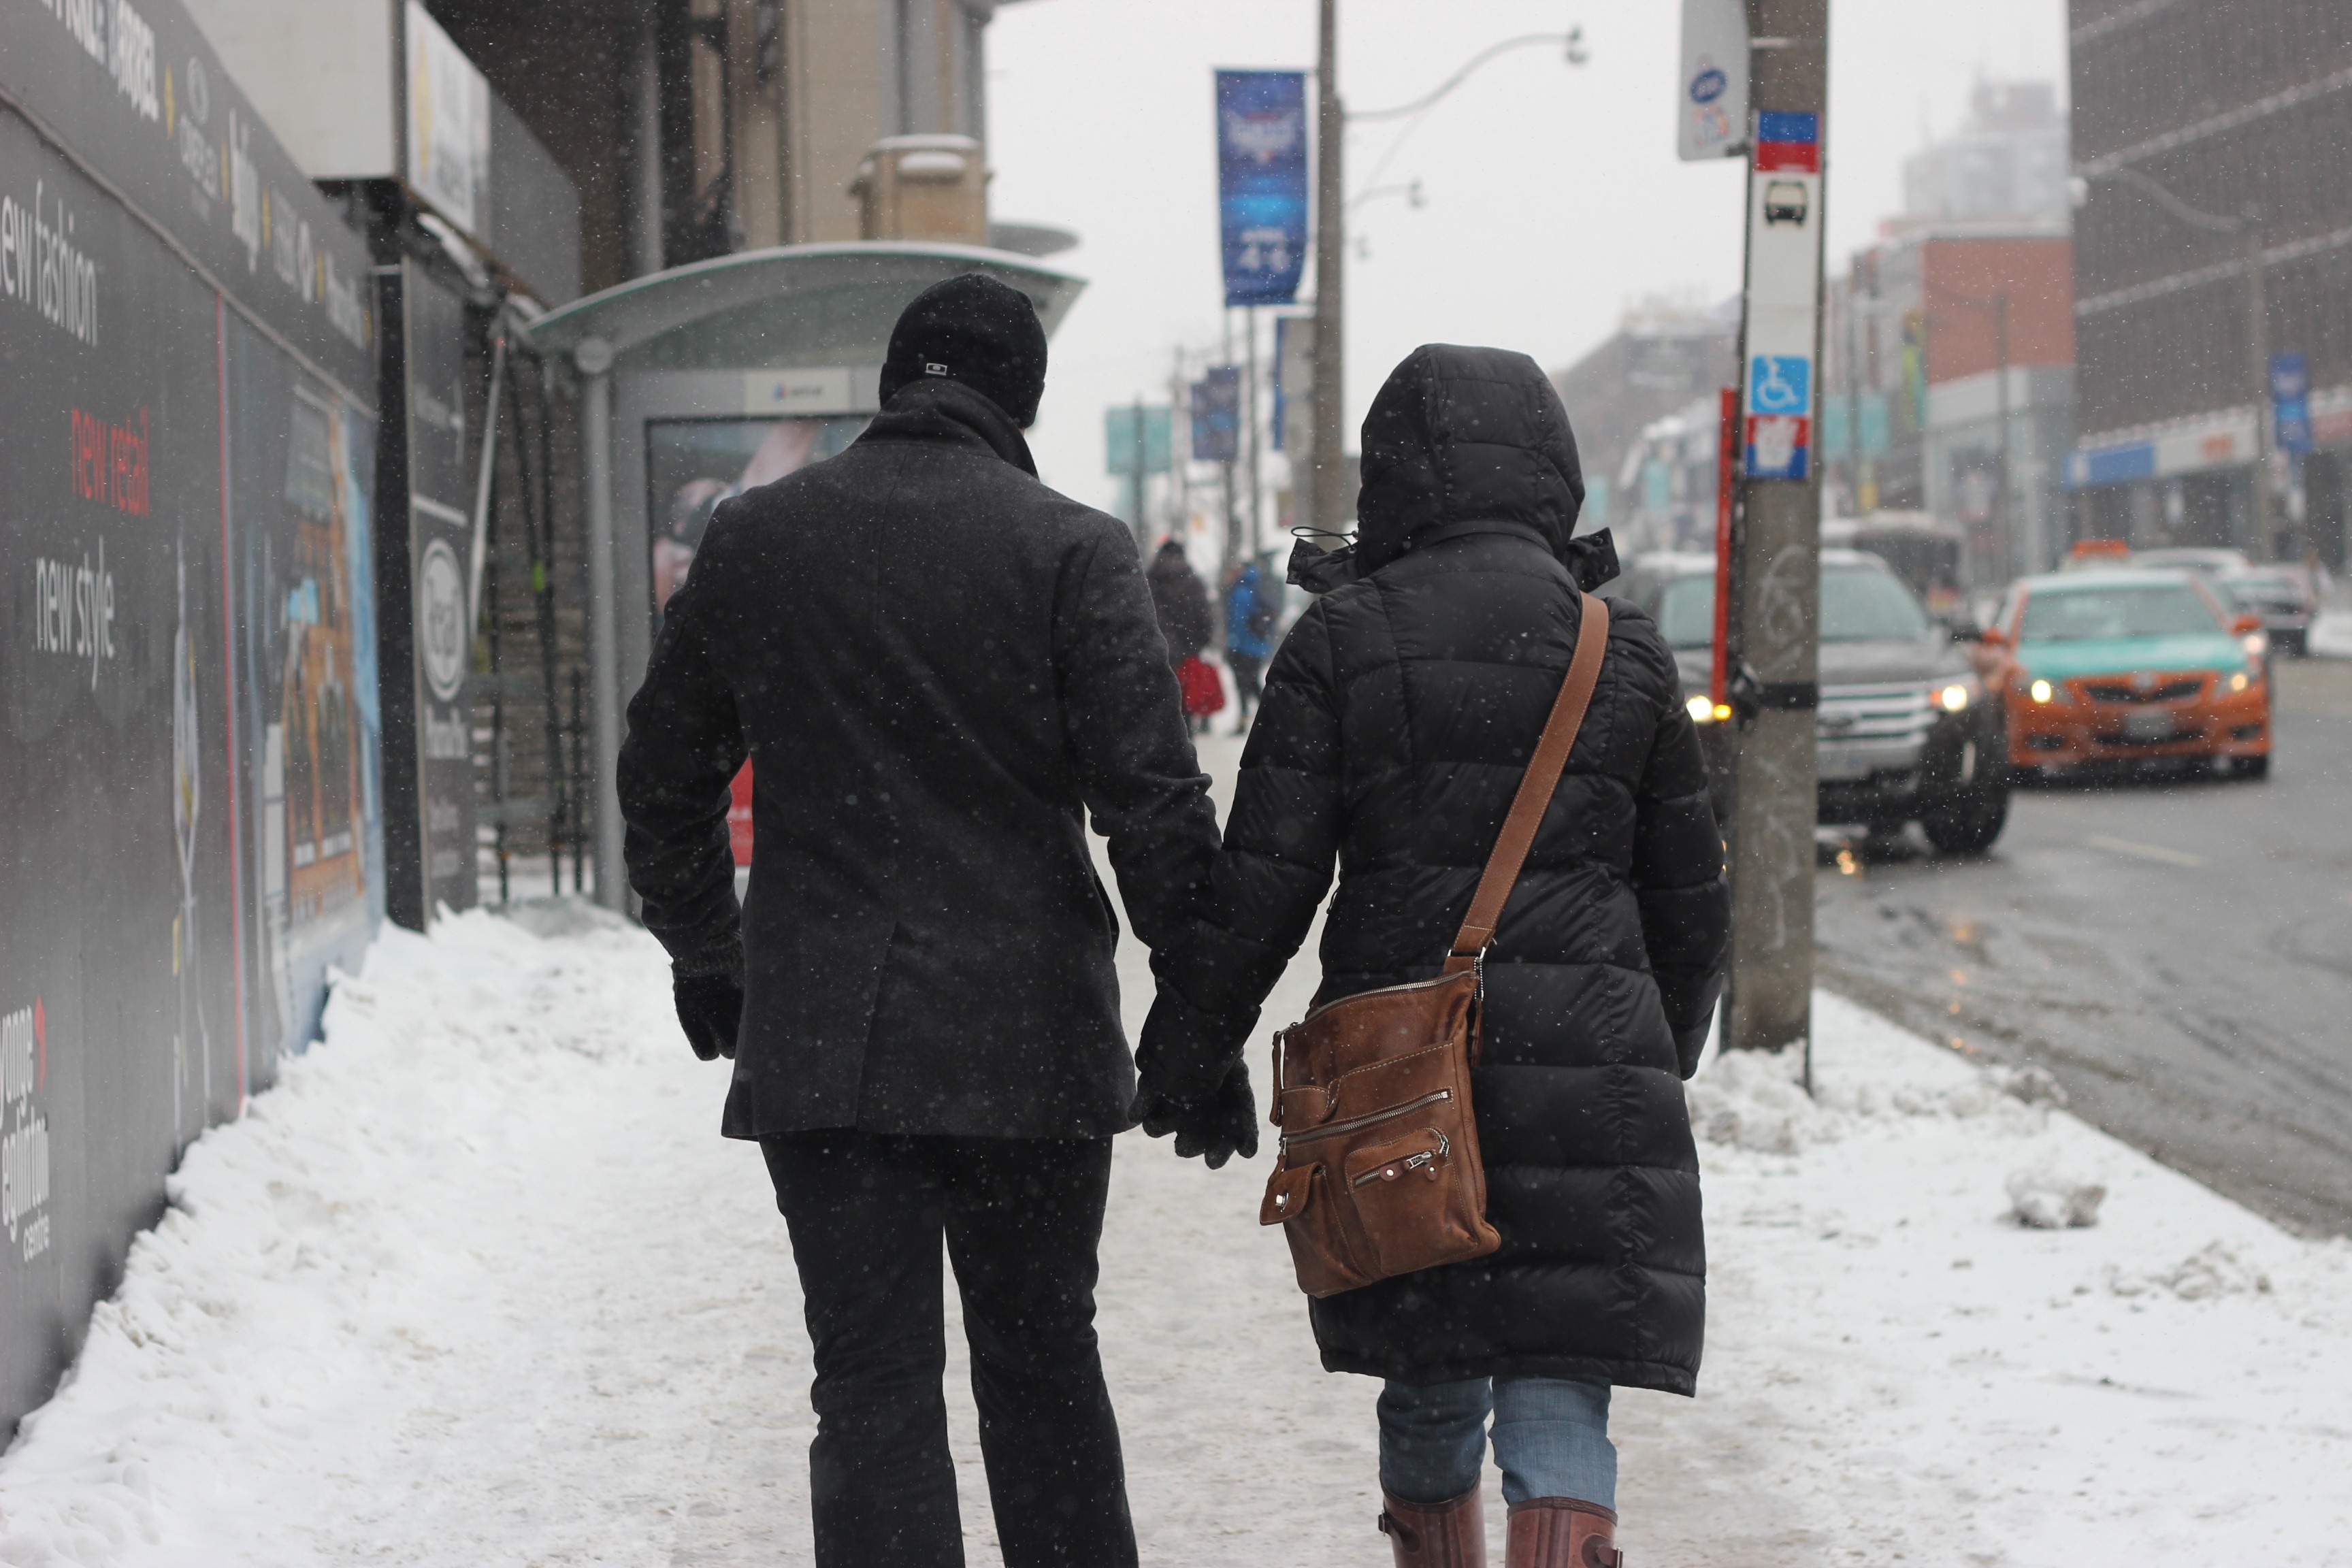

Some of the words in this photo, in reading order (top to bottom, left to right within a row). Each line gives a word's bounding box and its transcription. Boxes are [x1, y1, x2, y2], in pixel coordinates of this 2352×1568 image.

[0, 195, 33, 304] ew
[35, 178, 97, 348] fashion
[72, 408, 107, 502] new
[110, 405, 149, 517] retail
[36, 557, 72, 653] new
[76, 534, 114, 692] style
[2, 1105, 50, 1243] eglinton
[23, 1209, 50, 1262] centre
